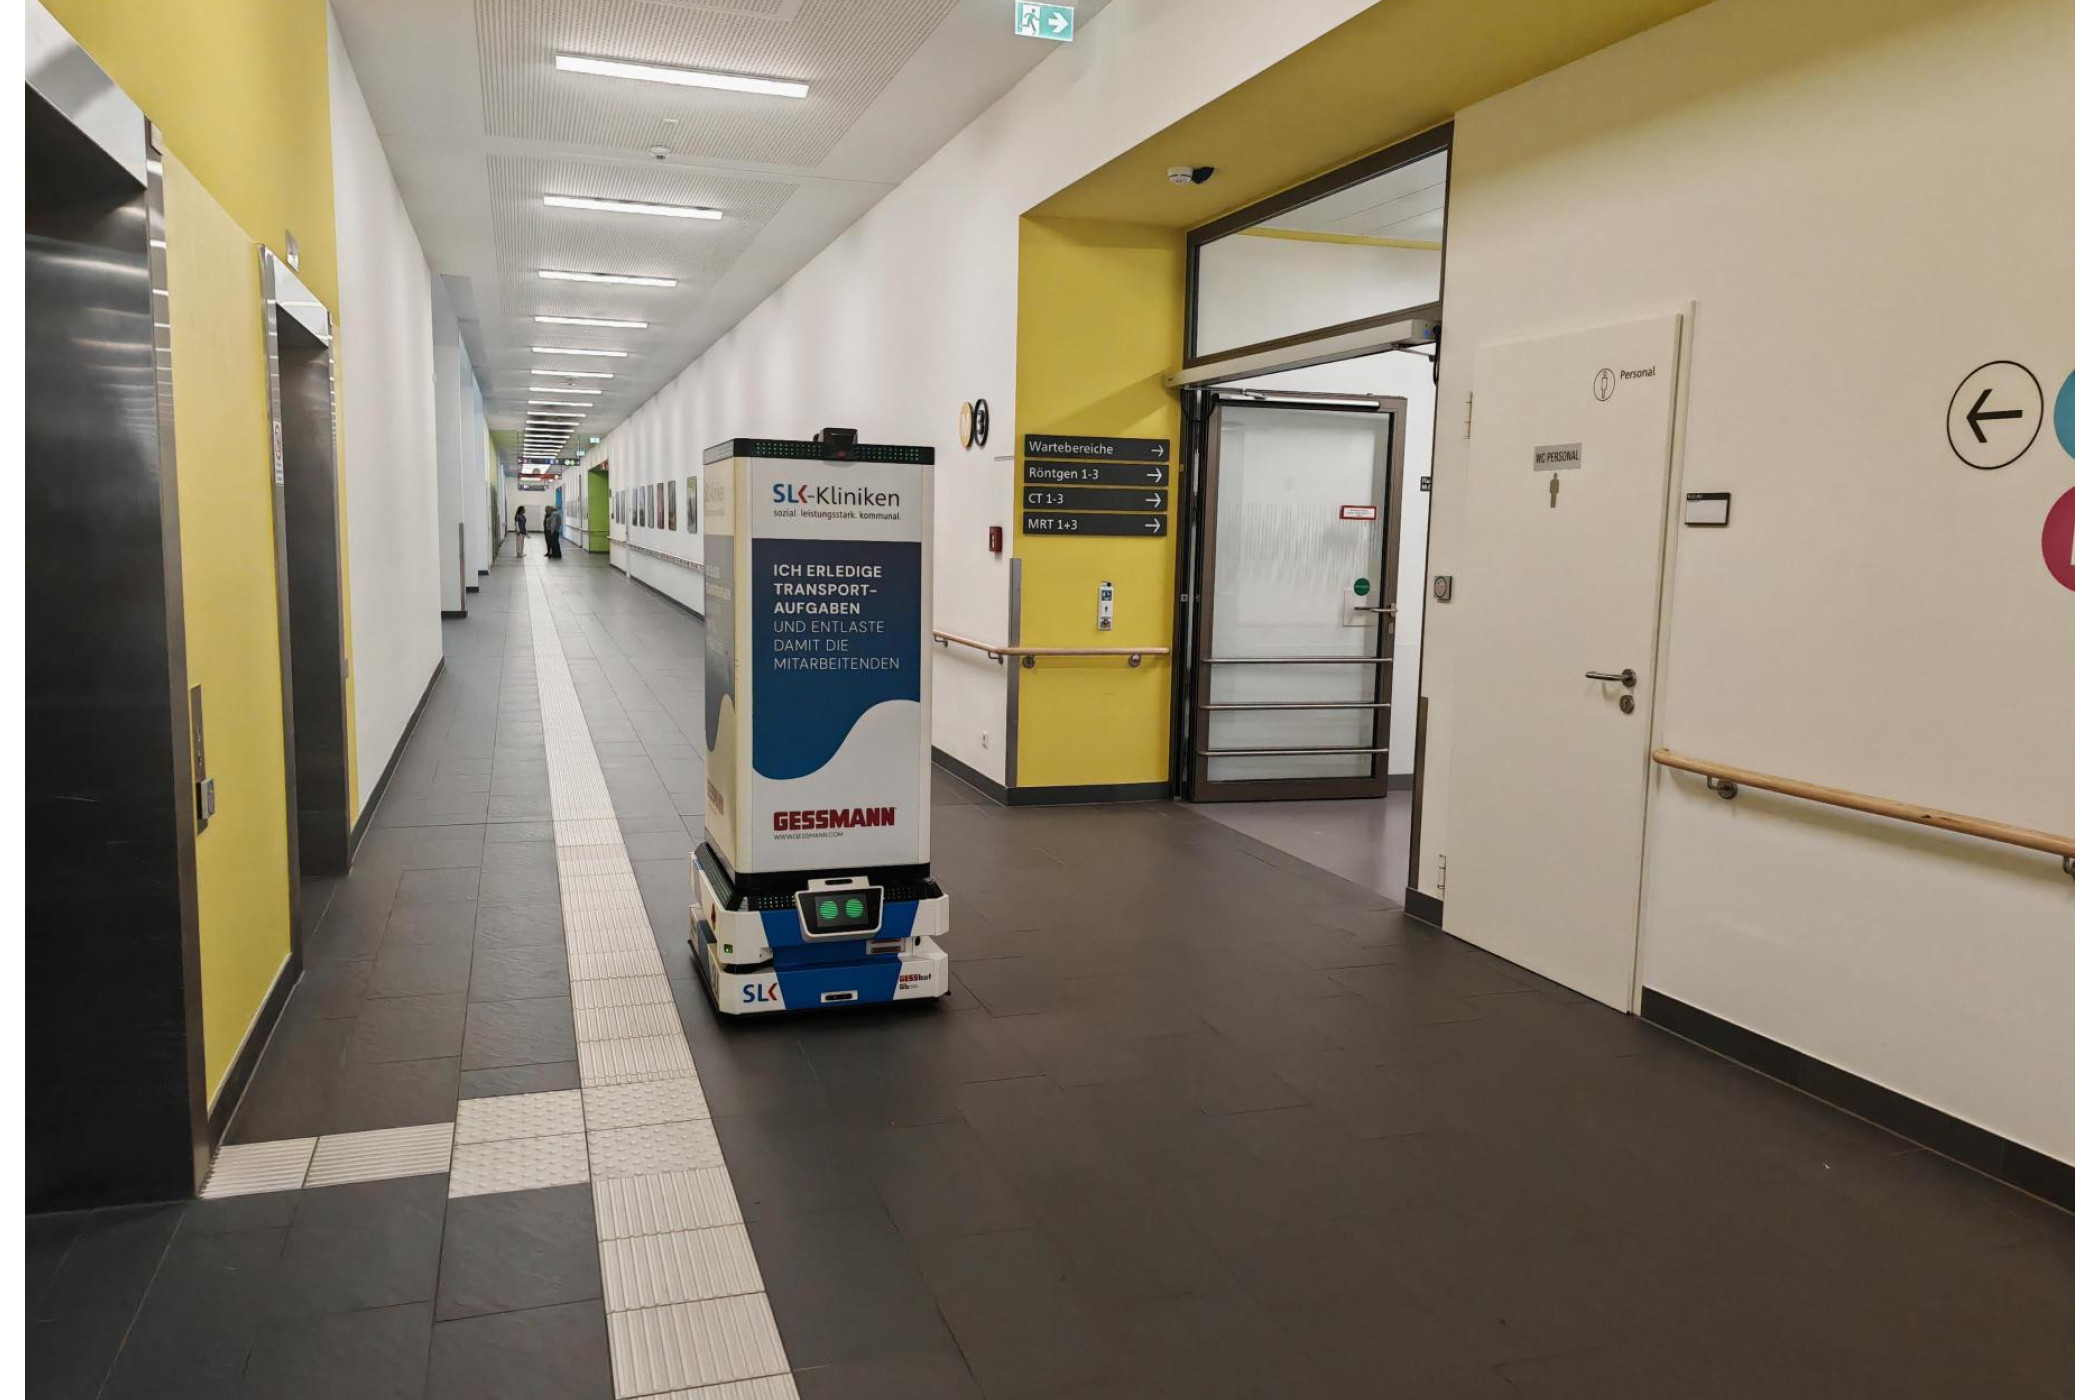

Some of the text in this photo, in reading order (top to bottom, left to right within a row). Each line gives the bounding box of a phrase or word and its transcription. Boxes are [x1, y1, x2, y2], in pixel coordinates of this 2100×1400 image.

[1620, 365, 1656, 380] Personal
[1029, 440, 1114, 455] Wartebereiche
[1536, 450, 1579, 463] WC PERSONAL
[1029, 467, 1099, 481] Röntgen 1-3
[772, 483, 900, 507] SLK-Kliniken
[1028, 492, 1064, 504] CT 1-3
[800, 509, 856, 520] leistungsstark.
[859, 510, 902, 520] kommunal.
[1028, 519, 1078, 530] MRT 1+3
[773, 564, 882, 578] ICH ERLEDIGE
[773, 583, 877, 596] TRANSPORT-
[773, 602, 861, 614] AUFGABEN
[773, 620, 885, 633] UND ENTLASTE
[774, 639, 849, 652] DAMIT DIE
[774, 657, 900, 670] MITARBEITENDEN
[773, 807, 895, 831] GESSMANN
